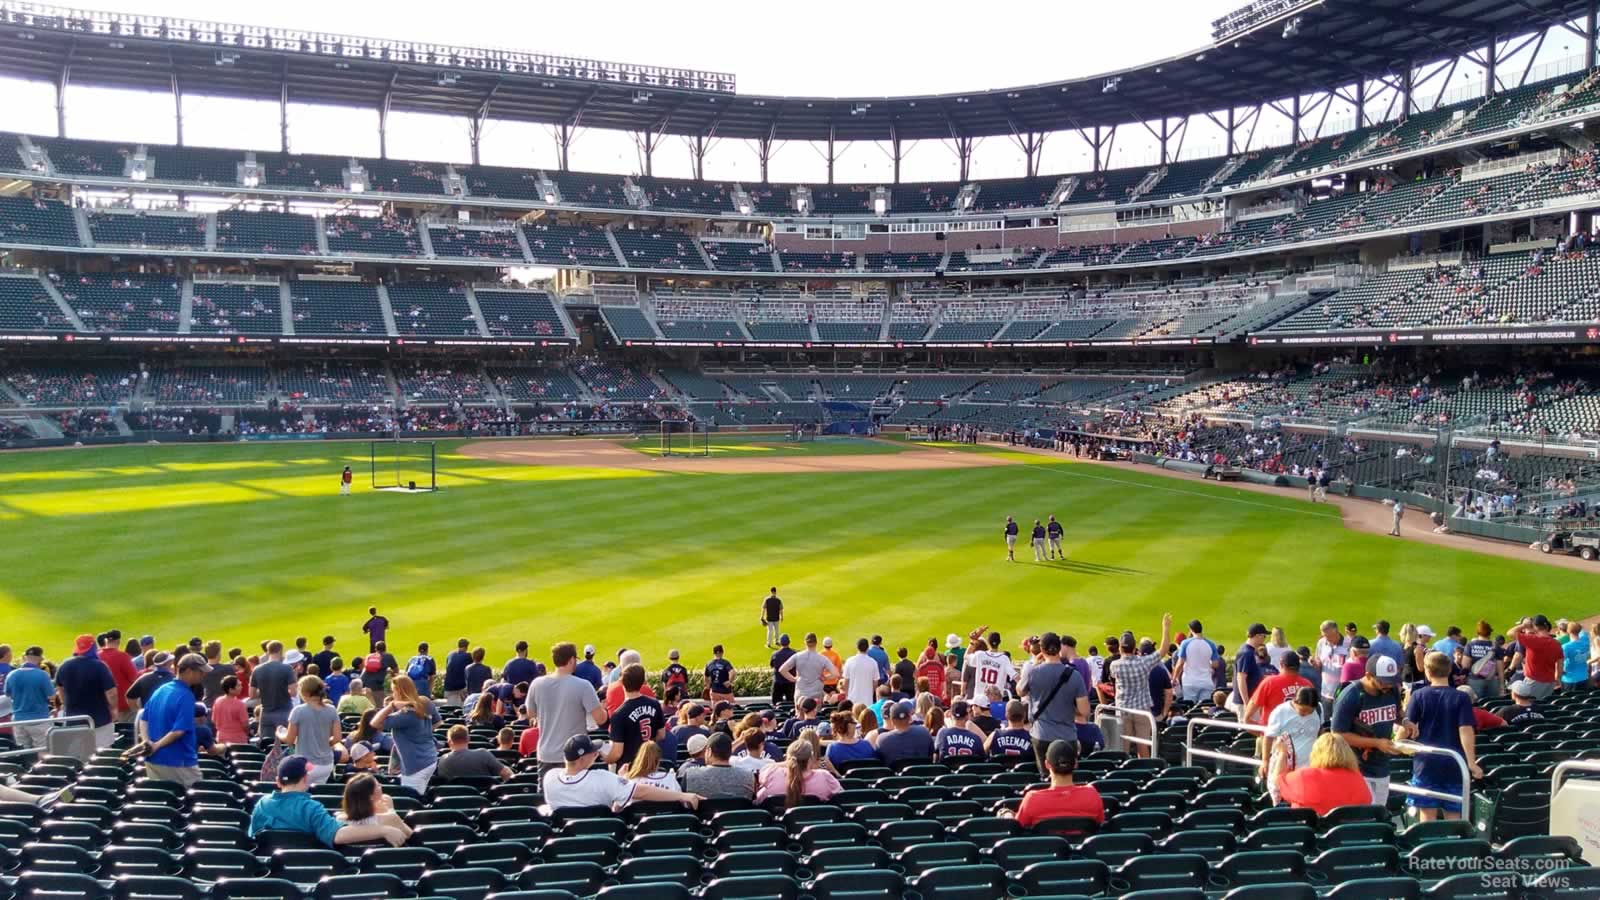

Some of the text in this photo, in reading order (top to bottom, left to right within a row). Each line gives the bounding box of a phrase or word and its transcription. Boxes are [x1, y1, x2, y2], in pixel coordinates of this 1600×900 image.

[980, 667, 998, 685] 10
[628, 705, 657, 722] FREEMAN
[639, 718, 652, 741] 5
[946, 734, 975, 748] ADAMS
[997, 735, 1031, 751] FREEMAN
